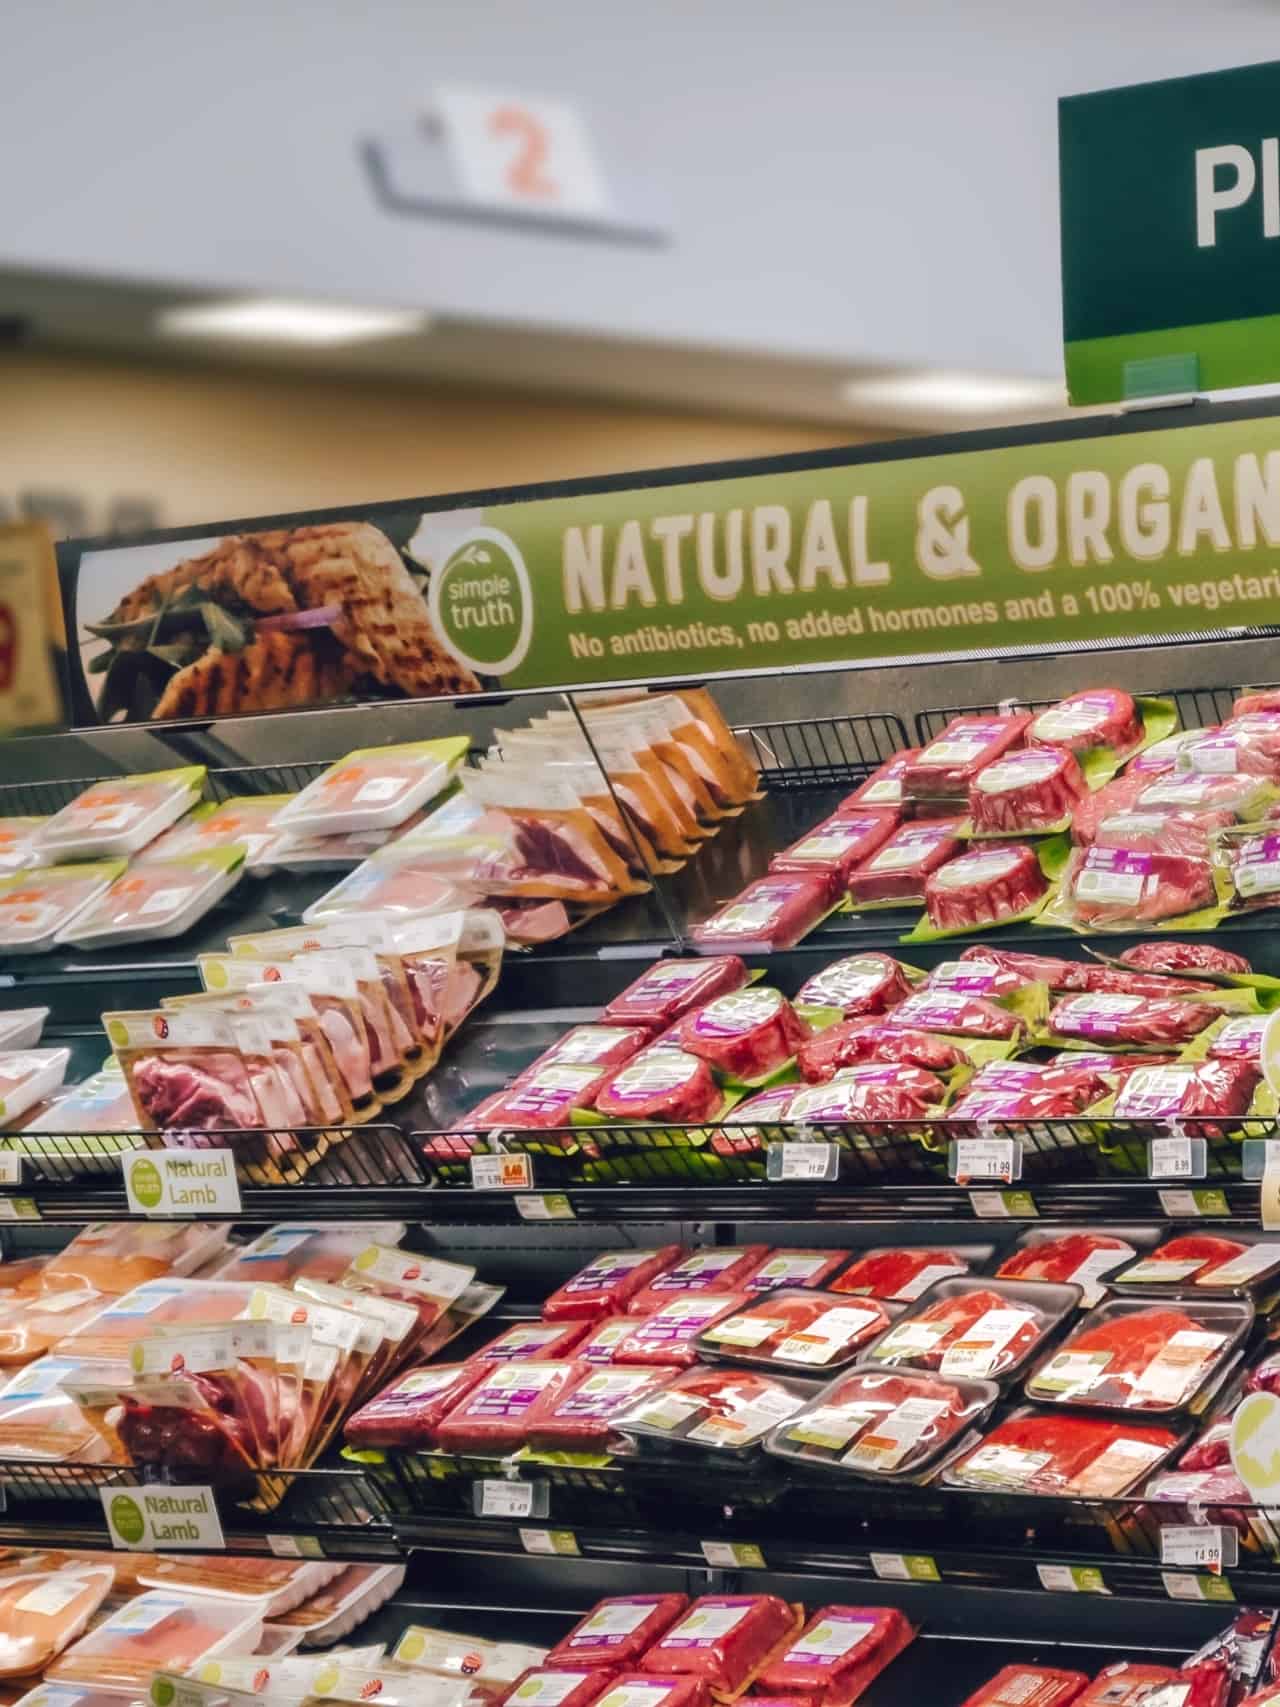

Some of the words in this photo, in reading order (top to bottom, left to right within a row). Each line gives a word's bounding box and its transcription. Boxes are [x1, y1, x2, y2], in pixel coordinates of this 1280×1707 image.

[487, 104, 560, 200] 2
[562, 495, 892, 614] NATURAL
[916, 485, 983, 580] &
[447, 574, 512, 601] simple
[452, 599, 515, 630] truth
[568, 632, 603, 659] No
[610, 620, 744, 657] antibiotics,
[748, 625, 781, 646] no
[786, 608, 865, 641] added
[868, 602, 998, 633] hormones
[1005, 589, 1057, 622] and
[1062, 597, 1080, 616] a
[1084, 580, 1160, 614] 100%
[165, 1155, 228, 1177] Natural
[987, 1160, 1011, 1174] 11.99
[169, 1183, 217, 1204] Lamb
[143, 1491, 209, 1514] Natural
[150, 1519, 201, 1540] Lamb
[1195, 1549, 1220, 1561] 14.99
